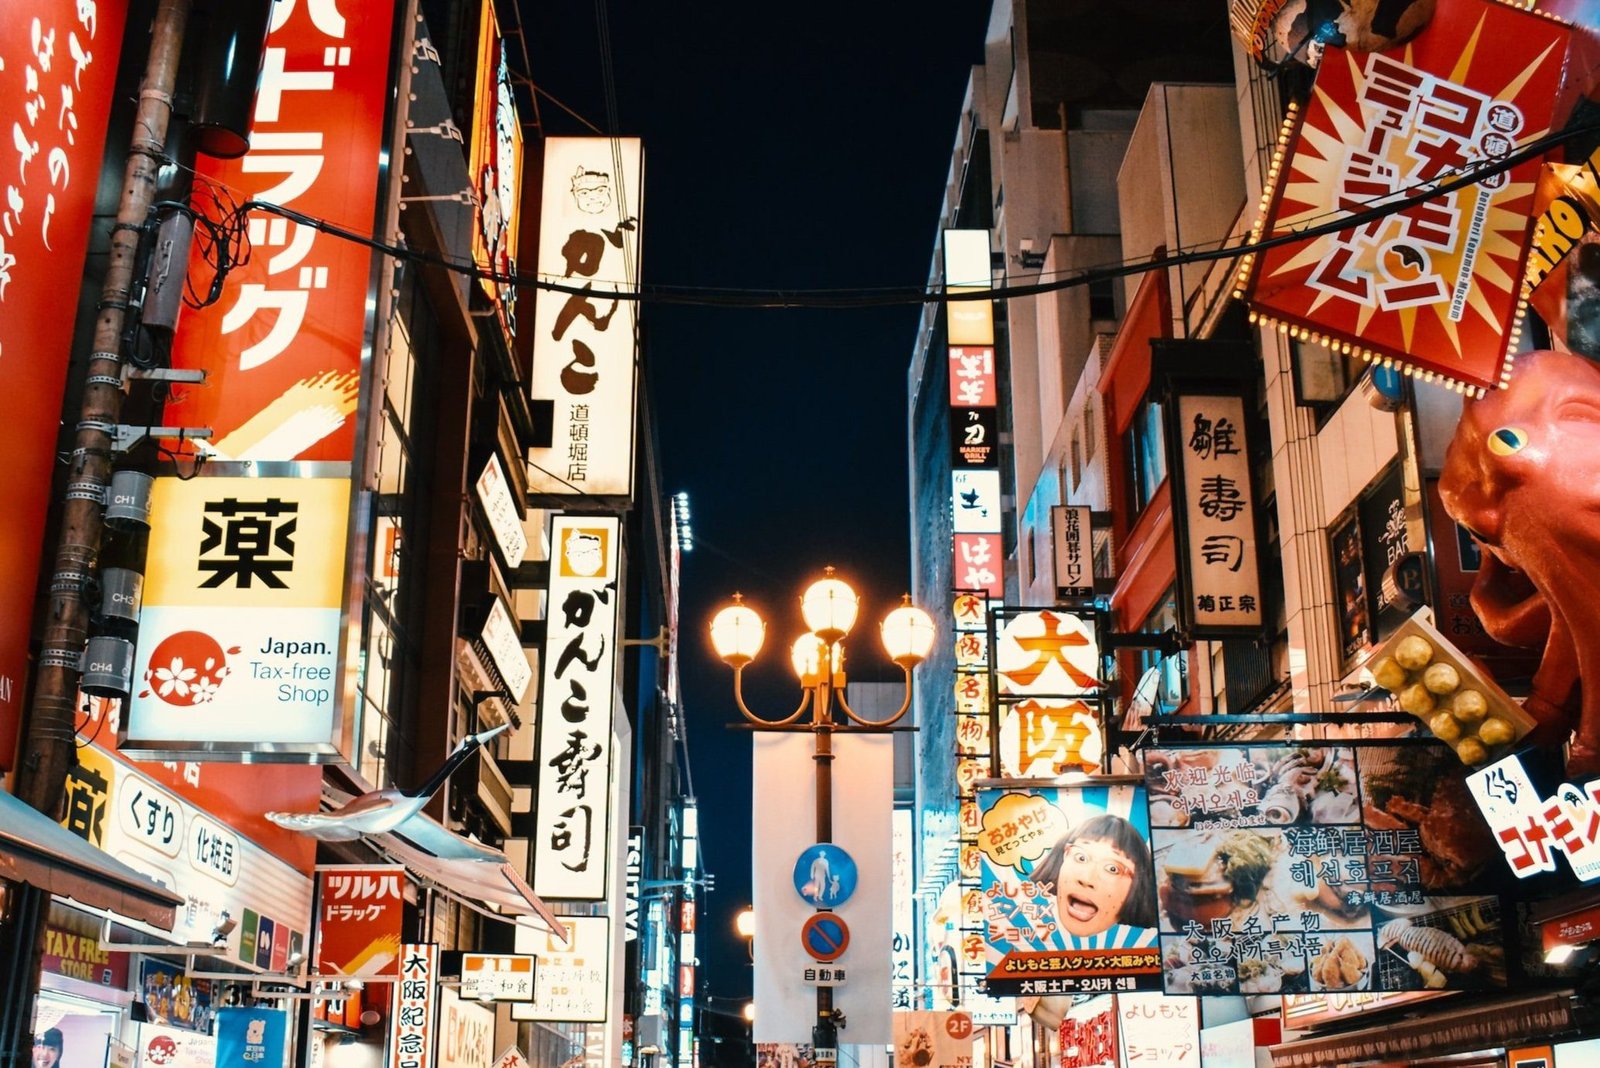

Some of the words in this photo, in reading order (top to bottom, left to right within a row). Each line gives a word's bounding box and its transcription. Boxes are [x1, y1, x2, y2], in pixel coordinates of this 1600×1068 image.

[552, 217, 638, 395] がんこ
[566, 404, 590, 482] 道頓堀店
[114, 495, 136, 506] CH1
[197, 498, 298, 589] 薬
[112, 592, 135, 605] CH3
[1196, 594, 1257, 614] 菊正宗
[260, 637, 332, 659] Japan.
[89, 662, 113, 672] CH4
[249, 662, 331, 680] Tax-free
[277, 684, 330, 706] Shop
[1162, 763, 1256, 790] 欢迎光临
[1172, 789, 1261, 814] 어서오세요
[130, 790, 175, 845] くすり
[987, 808, 1048, 846] おみやげ
[1195, 815, 1267, 831] いらっしゃいませ
[197, 826, 233, 877] 化粧品
[1290, 858, 1421, 887] 해선호프집
[328, 875, 400, 899] ツルハ
[625, 835, 641, 943] TSUTAYA
[986, 881, 1054, 898] よしもと
[326, 903, 387, 922] ドラッグ
[988, 902, 1055, 921] エンタメ
[988, 922, 1056, 942] ショップ
[1183, 911, 1321, 941] 大阪名产物
[45, 930, 76, 958] TAX
[79, 938, 109, 965] FREE
[60, 958, 94, 980] STORE
[803, 968, 846, 982] 自動車
[1126, 1003, 1189, 1019] よしもと
[948, 1019, 970, 1033] 2F
[1127, 1042, 1194, 1061] ショップ
